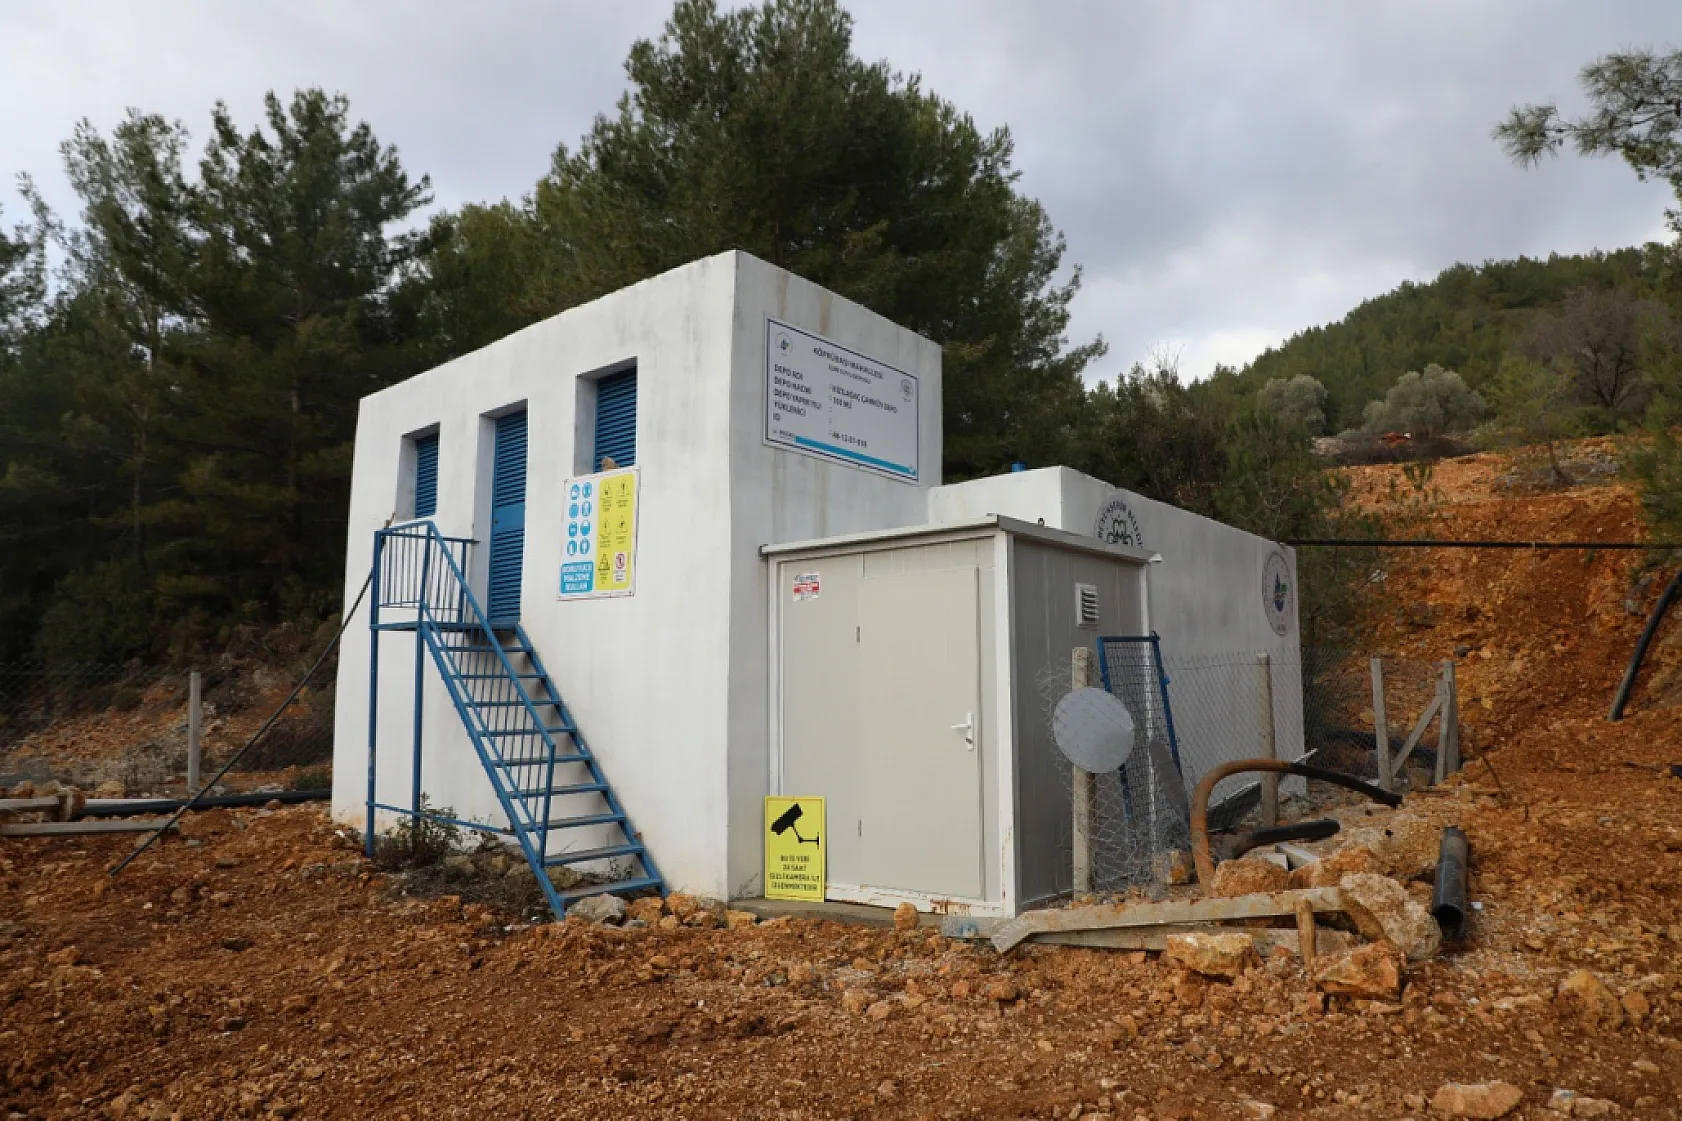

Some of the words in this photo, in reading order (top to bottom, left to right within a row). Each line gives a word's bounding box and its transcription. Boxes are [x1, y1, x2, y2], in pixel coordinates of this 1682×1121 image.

[774, 363, 791, 377] DEPO
[774, 375, 791, 388] DEPO
[774, 388, 791, 401] DEPO
